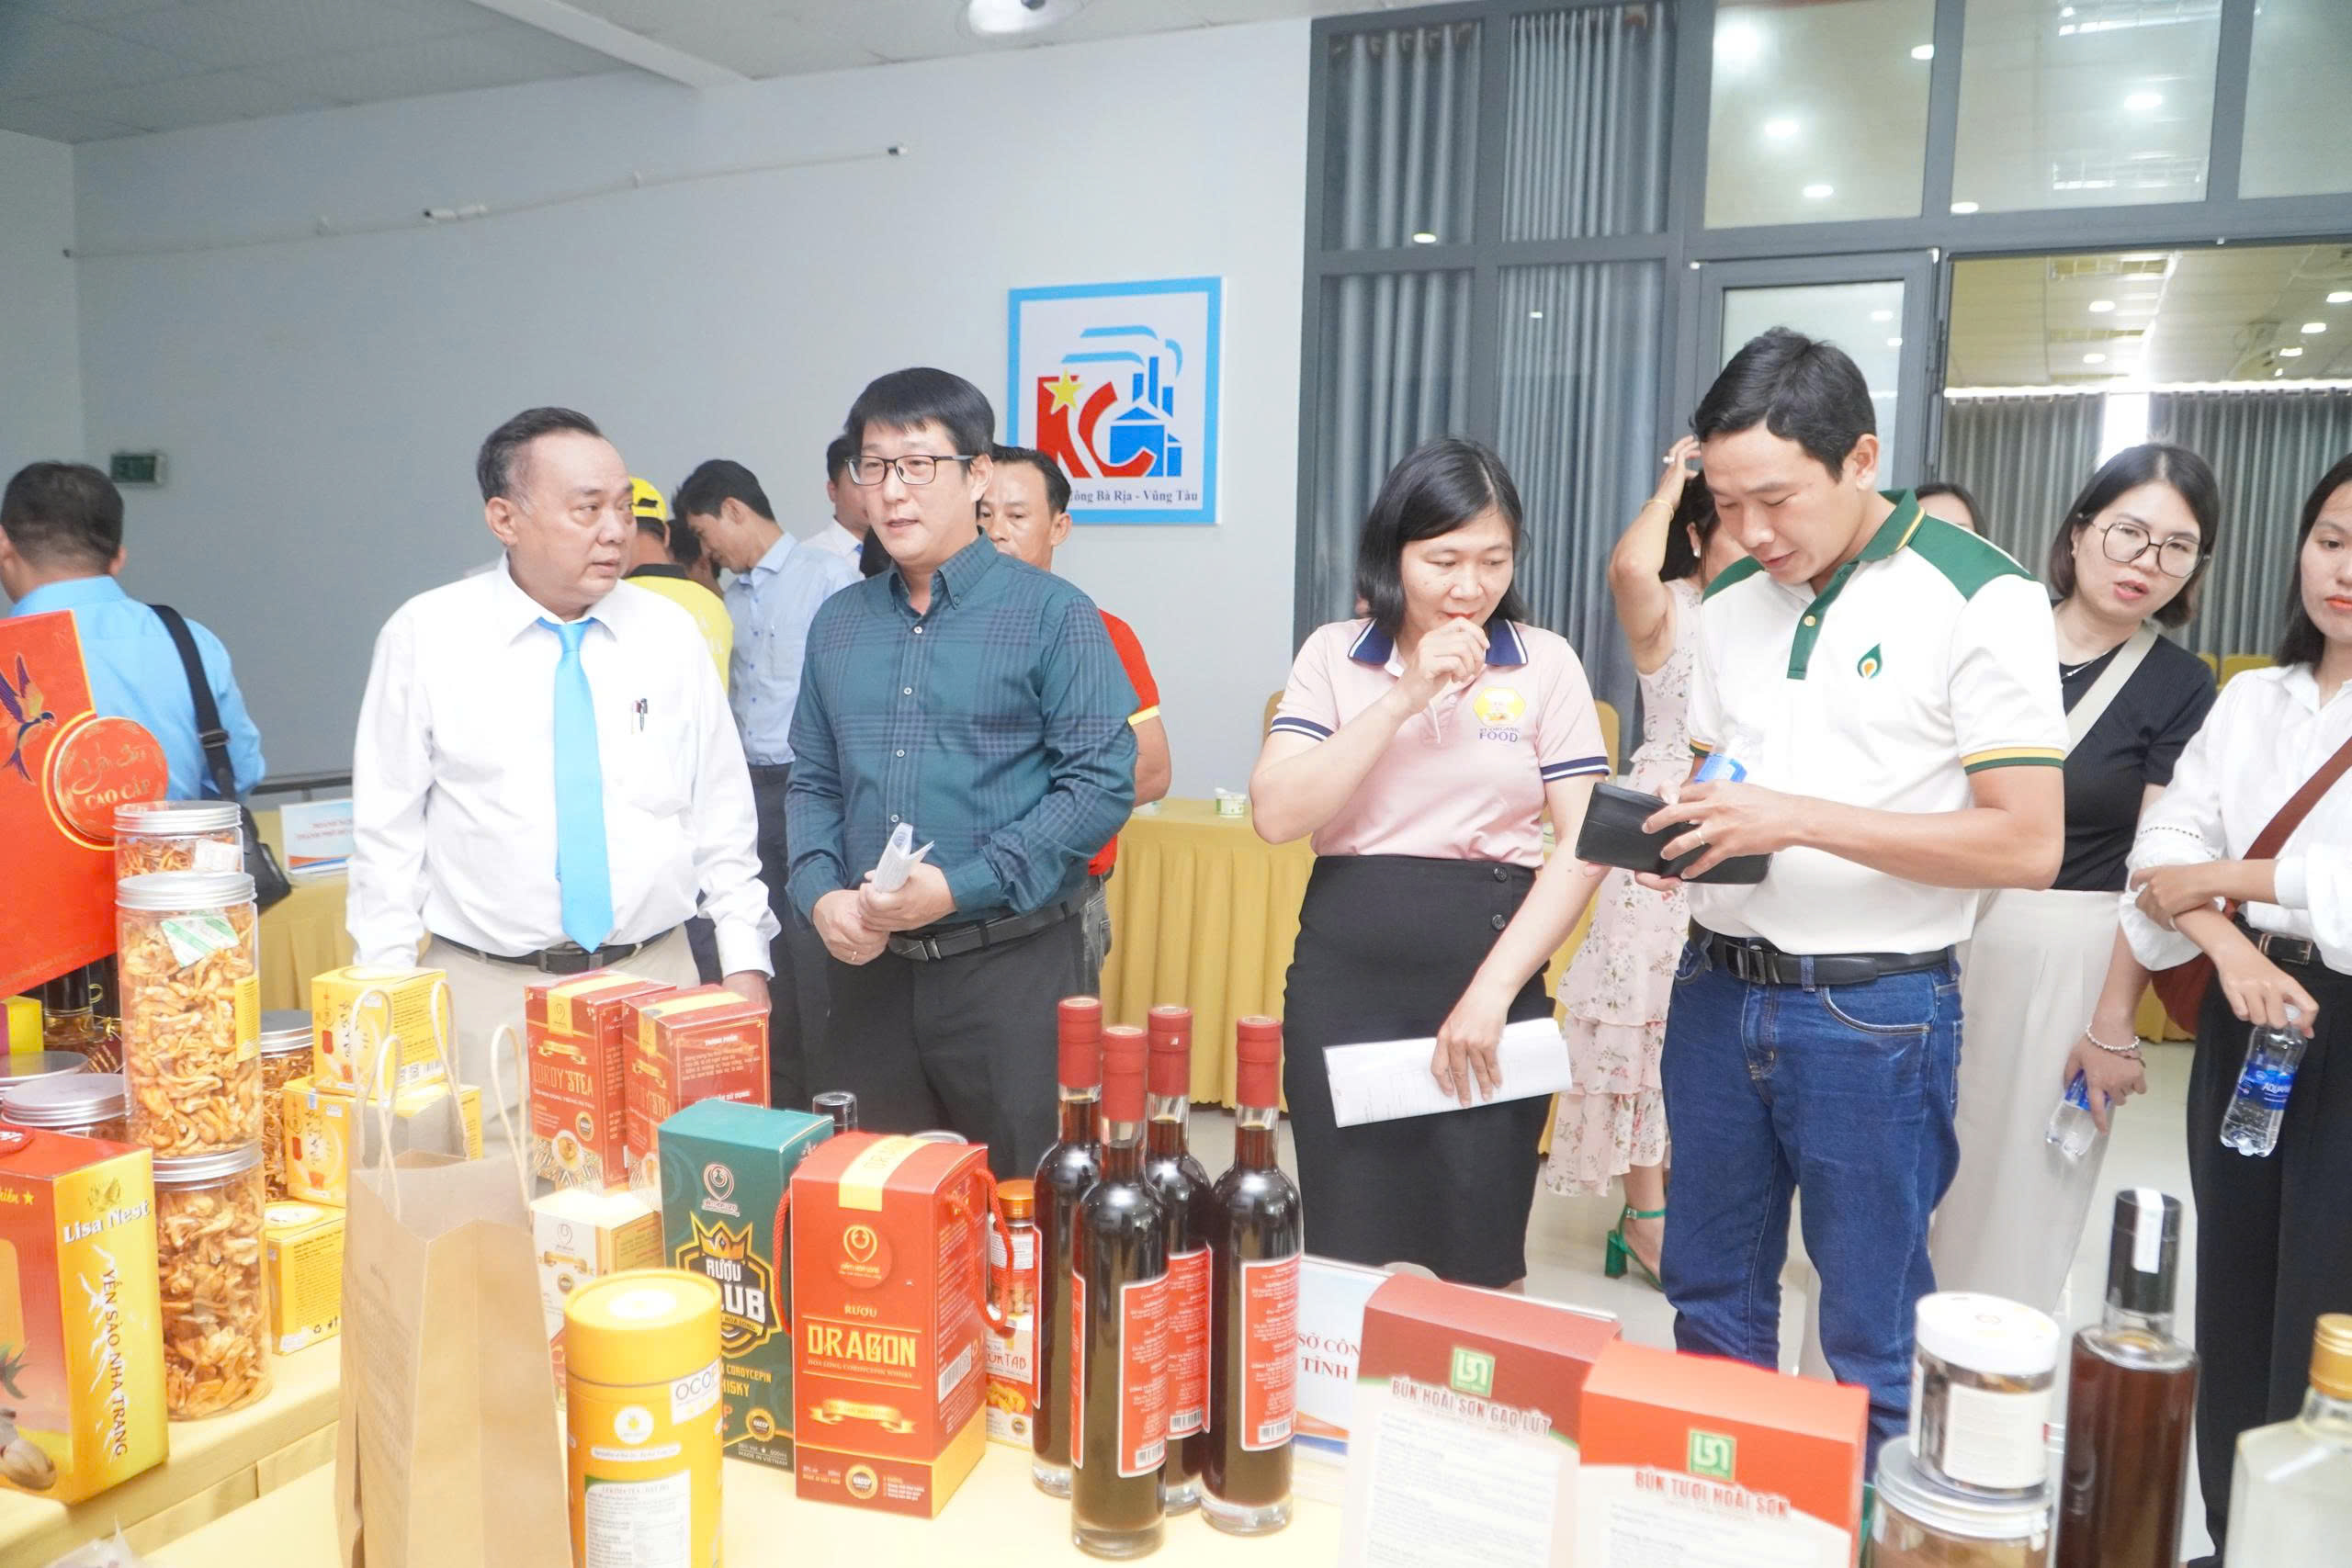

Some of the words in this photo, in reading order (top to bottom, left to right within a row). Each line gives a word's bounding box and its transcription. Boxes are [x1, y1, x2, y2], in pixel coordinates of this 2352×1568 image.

[1069, 491, 1093, 503] ông
[1096, 490, 1111, 502] Bà
[1114, 490, 1133, 504] Rịa
[1144, 490, 1173, 503] Vũng
[1177, 490, 1198, 502] Tàu
[1479, 731, 1519, 743] FOOD
[63, 1219, 104, 1244] Lisa
[107, 1200, 152, 1228] Nest
[706, 1258, 742, 1283] RƯỢU
[844, 1303, 877, 1317] RƯỢU
[808, 1324, 917, 1368] DRAGON
[109, 1352, 125, 1392] NHA
[726, 1365, 773, 1384] CORDYCEPIN
[113, 1394, 128, 1457] TRANG
